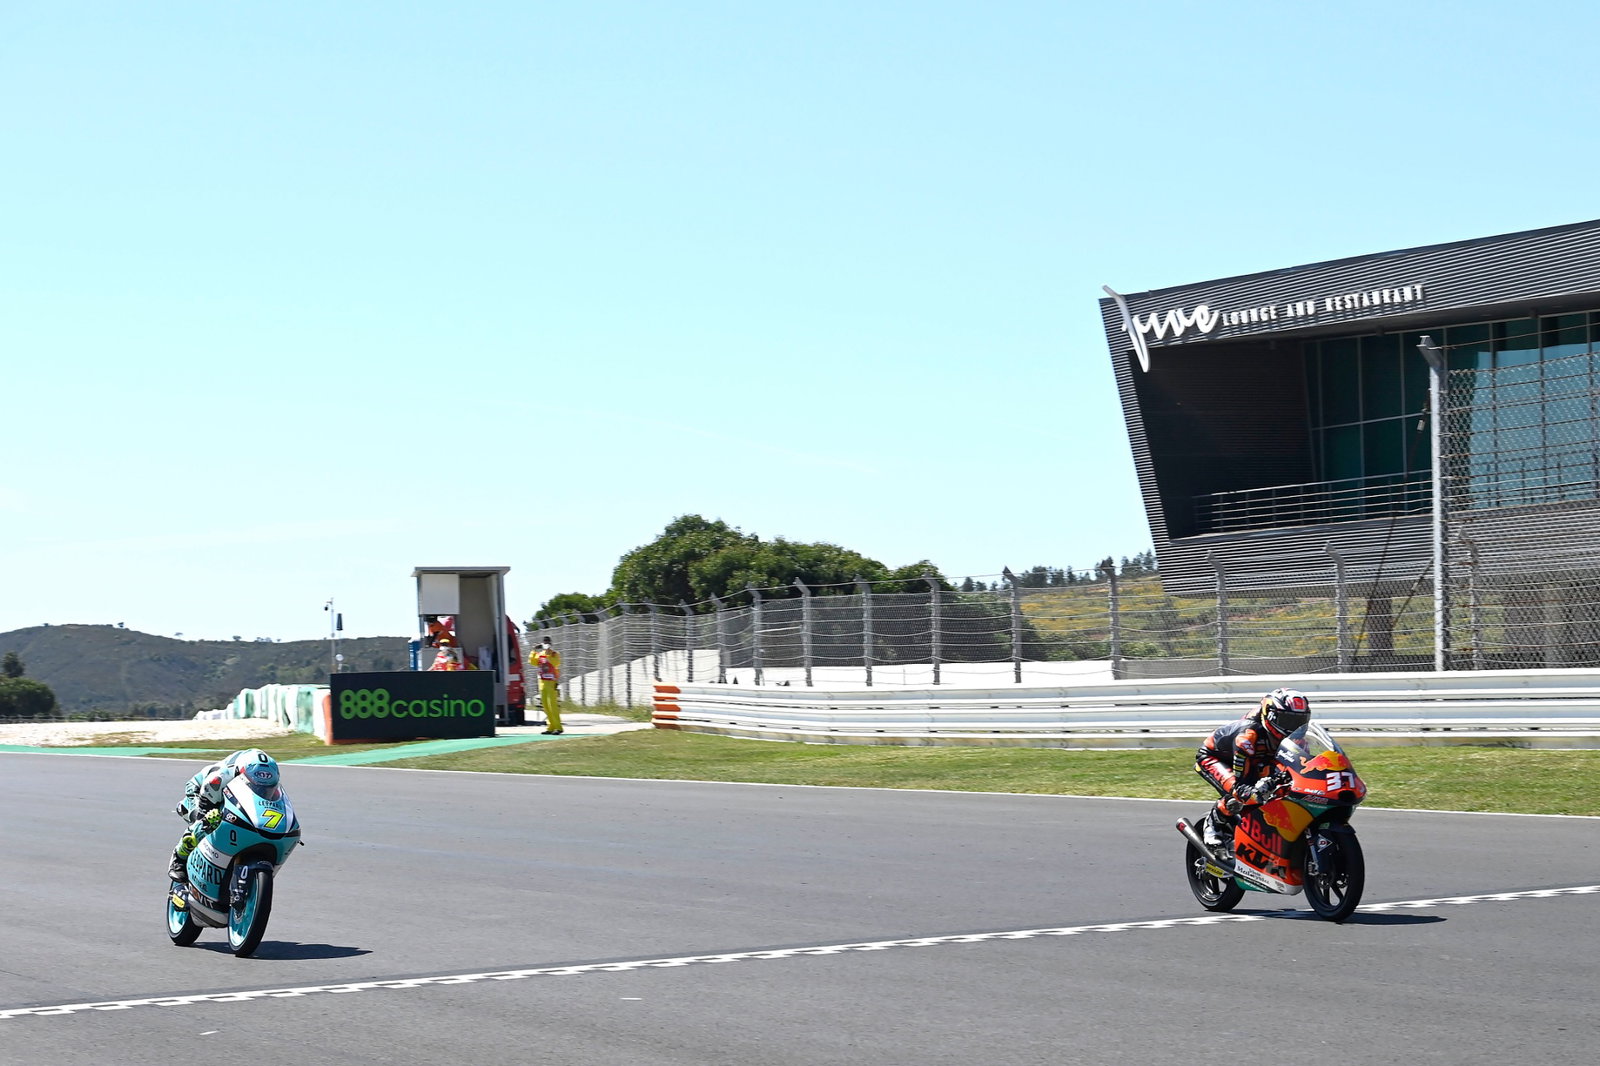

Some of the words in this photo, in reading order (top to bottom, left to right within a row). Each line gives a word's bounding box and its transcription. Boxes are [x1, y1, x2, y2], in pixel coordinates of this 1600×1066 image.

[1222, 305, 1278, 326] LOUNGE
[1286, 300, 1316, 318] AND
[1325, 284, 1424, 312] RESTAURANT
[1326, 771, 1356, 792] 37
[262, 809, 284, 829] 7
[1251, 820, 1282, 855] Bull
